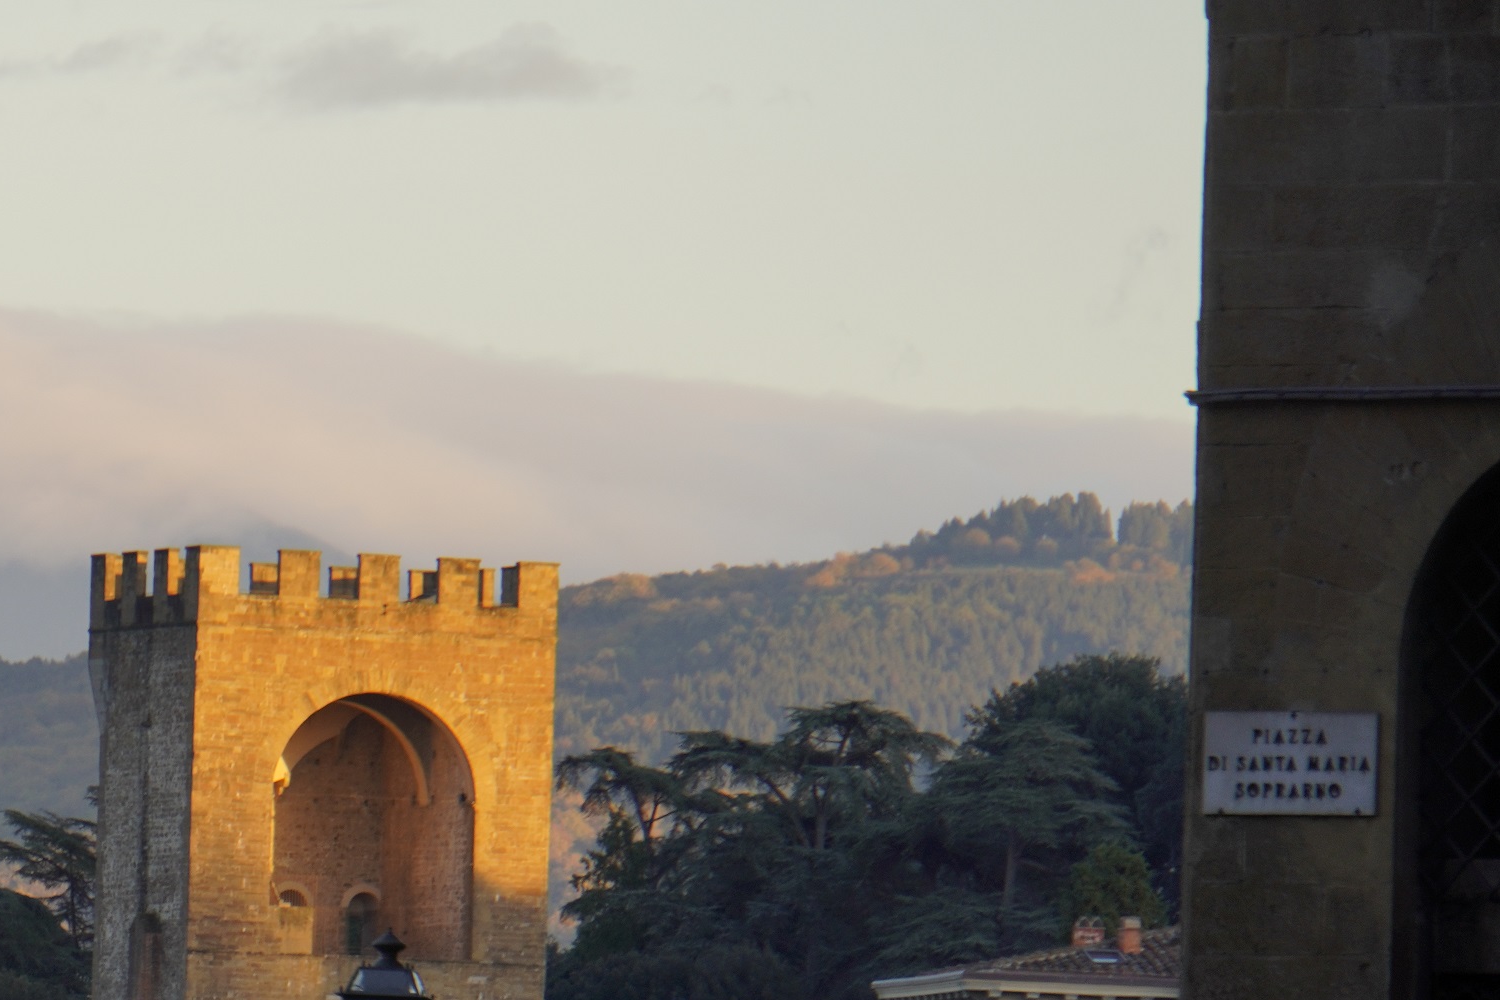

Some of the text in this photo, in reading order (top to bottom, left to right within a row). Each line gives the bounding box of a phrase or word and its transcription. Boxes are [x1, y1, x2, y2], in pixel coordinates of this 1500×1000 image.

[1253, 729, 1327, 745] PIAZZA
[1208, 756, 1371, 773] DI SANTA MARIA
[1235, 782, 1342, 799] SOPRARNO
